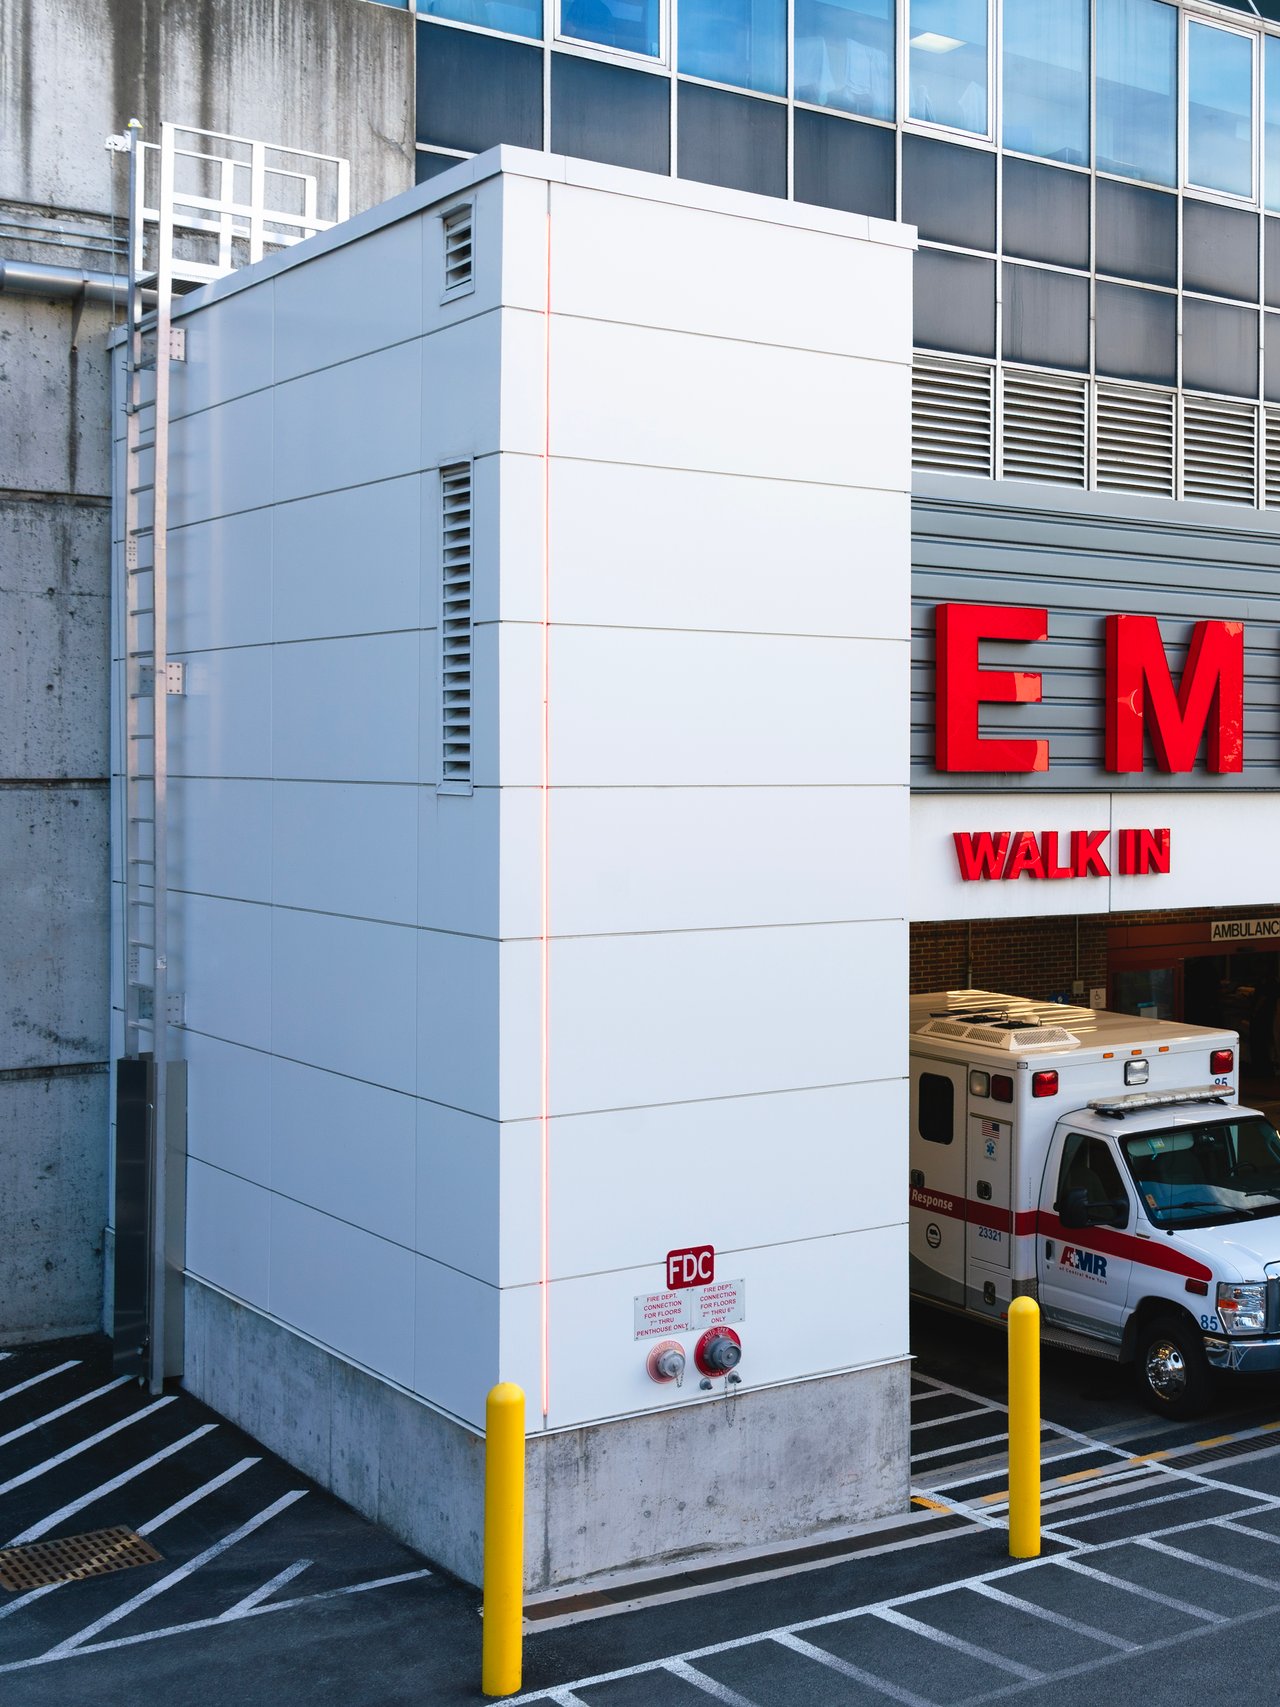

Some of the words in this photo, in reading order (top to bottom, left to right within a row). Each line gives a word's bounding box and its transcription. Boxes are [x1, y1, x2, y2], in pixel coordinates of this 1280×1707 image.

[953, 830, 1111, 881] WALK
[1119, 829, 1170, 874] IN
[911, 1189, 954, 1211] Response
[978, 1226, 1002, 1242] 23321
[1060, 1245, 1108, 1278] AMR
[669, 1251, 712, 1285] FDC
[646, 1294, 660, 1303] FIRE
[700, 1291, 737, 1302] CONNECTION
[643, 1300, 682, 1311] CONNECTION
[713, 1299, 736, 1308] FLOORS
[658, 1308, 682, 1317] FLOORS
[658, 1317, 675, 1325] THRU
[711, 1316, 726, 1324] ONLY
[1200, 1314, 1218, 1331] 85
[636, 1326, 673, 1337] PENTHOUSE
[673, 1323, 689, 1331] ONLY
